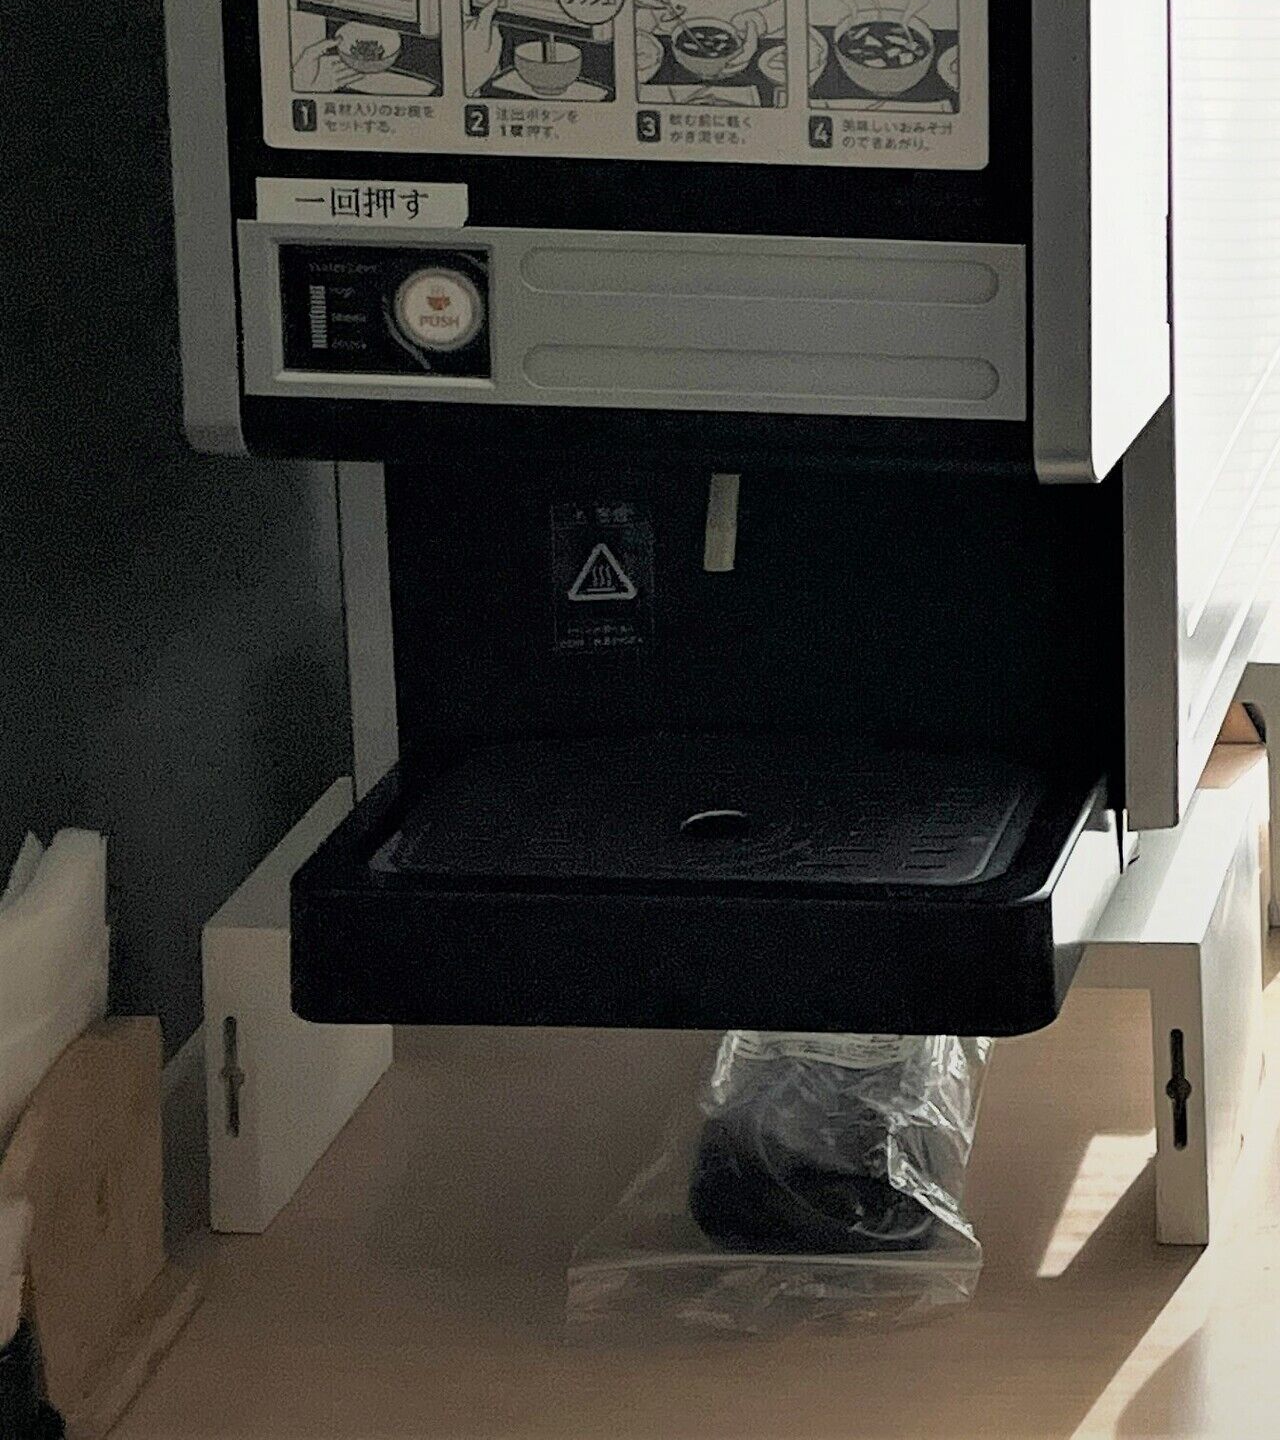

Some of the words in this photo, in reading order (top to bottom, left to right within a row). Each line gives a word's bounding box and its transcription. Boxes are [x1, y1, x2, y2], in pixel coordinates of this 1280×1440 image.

[294, 187, 429, 219] 一回押す
[419, 315, 461, 329] PUSH
